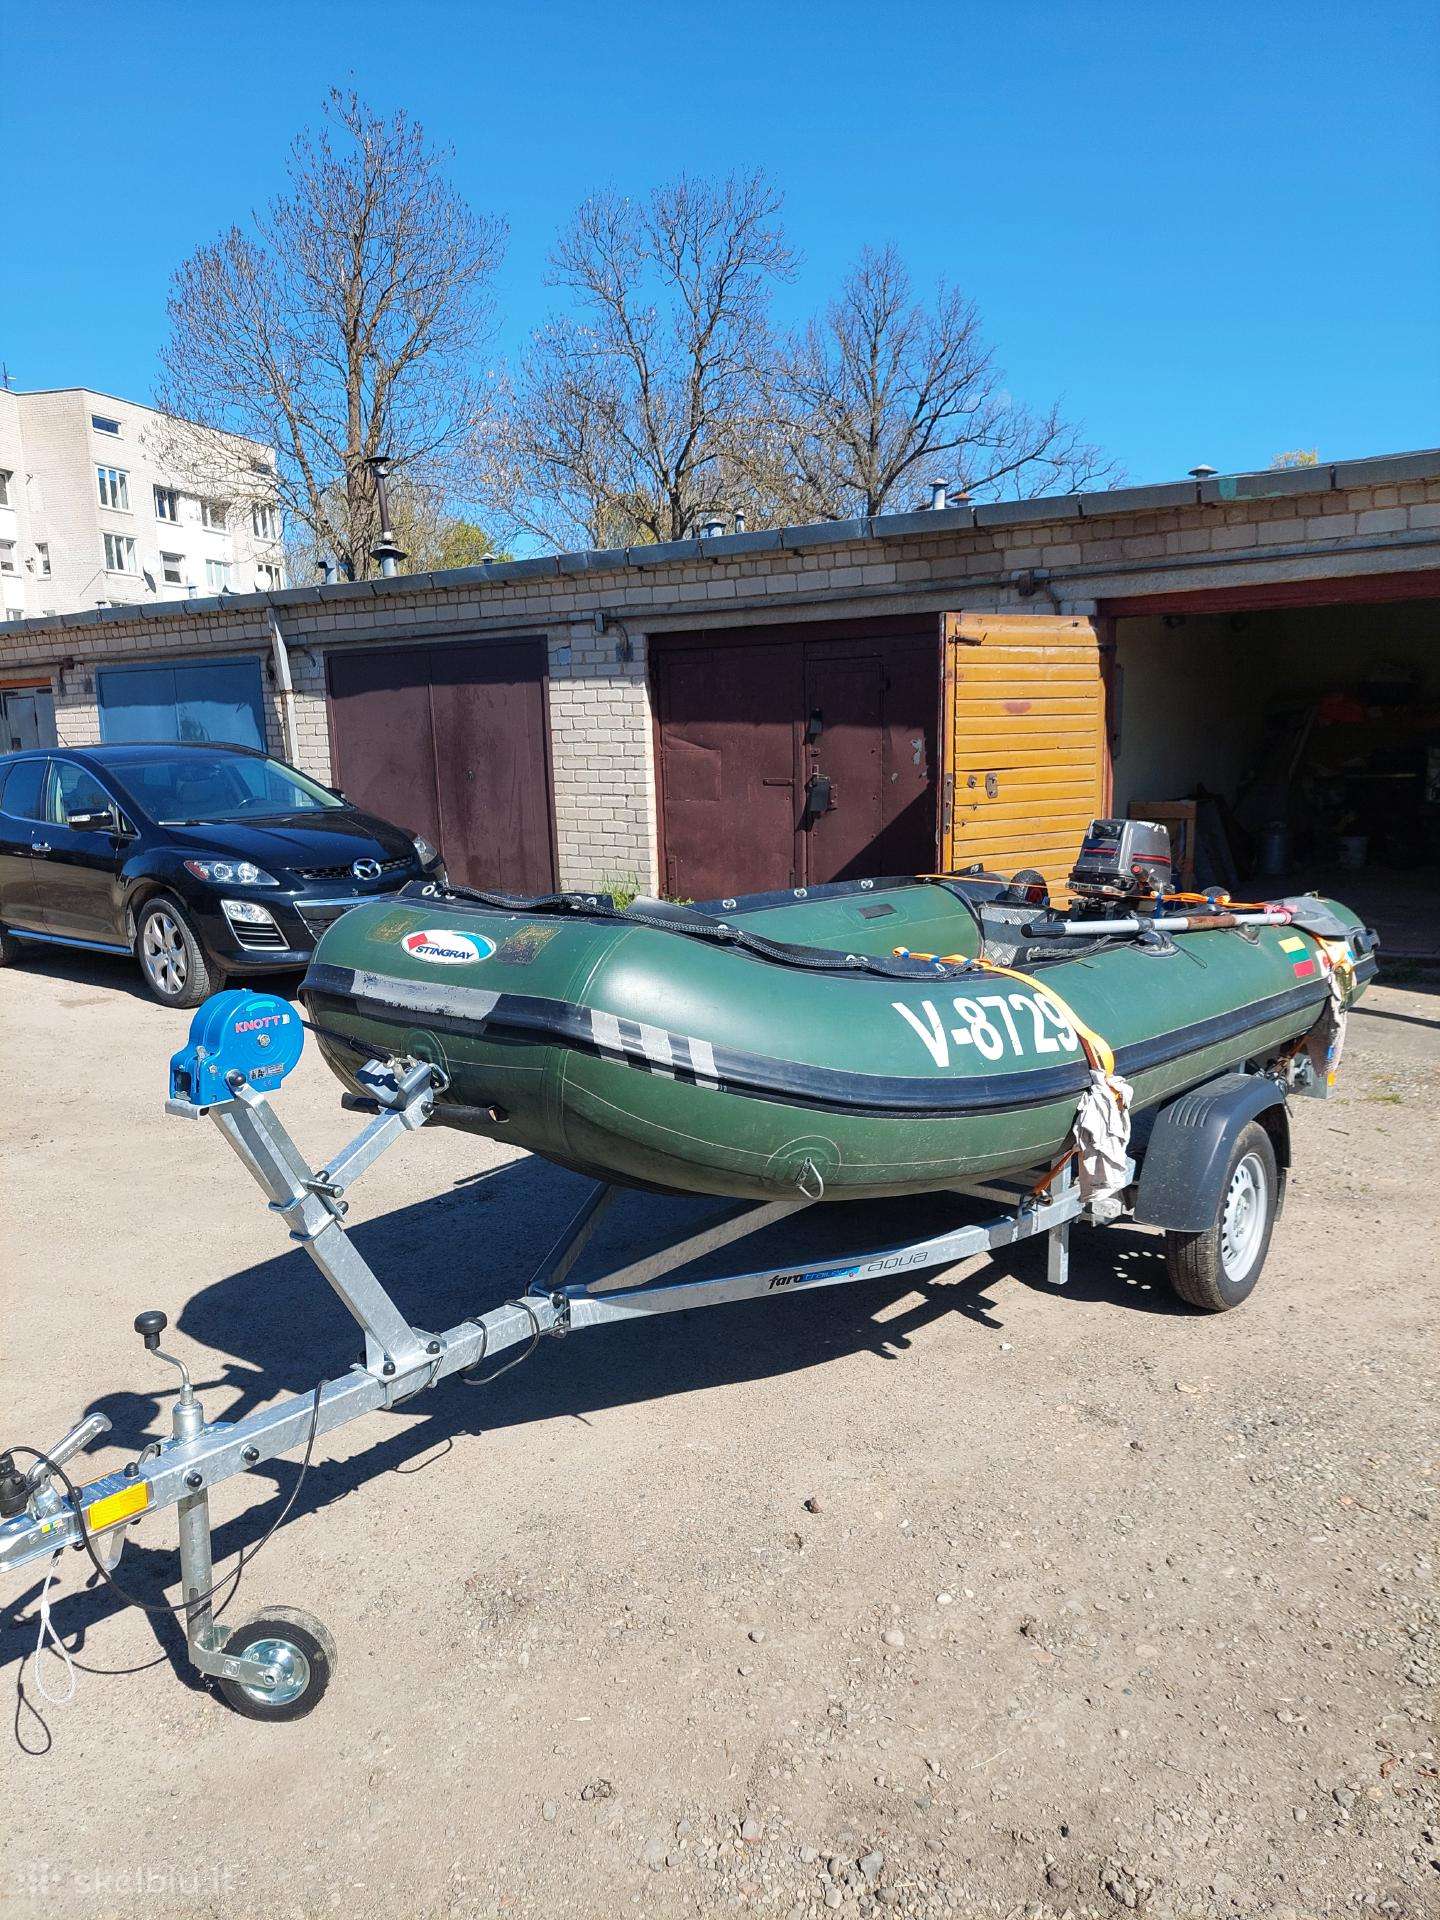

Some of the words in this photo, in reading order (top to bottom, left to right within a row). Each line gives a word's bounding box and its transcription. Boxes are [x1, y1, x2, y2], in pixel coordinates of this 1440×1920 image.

[415, 945, 475, 960] STINGRAY
[235, 1015, 281, 1034] KNOTT
[890, 993, 1078, 1068] V-8729
[867, 1251, 929, 1272] aqua
